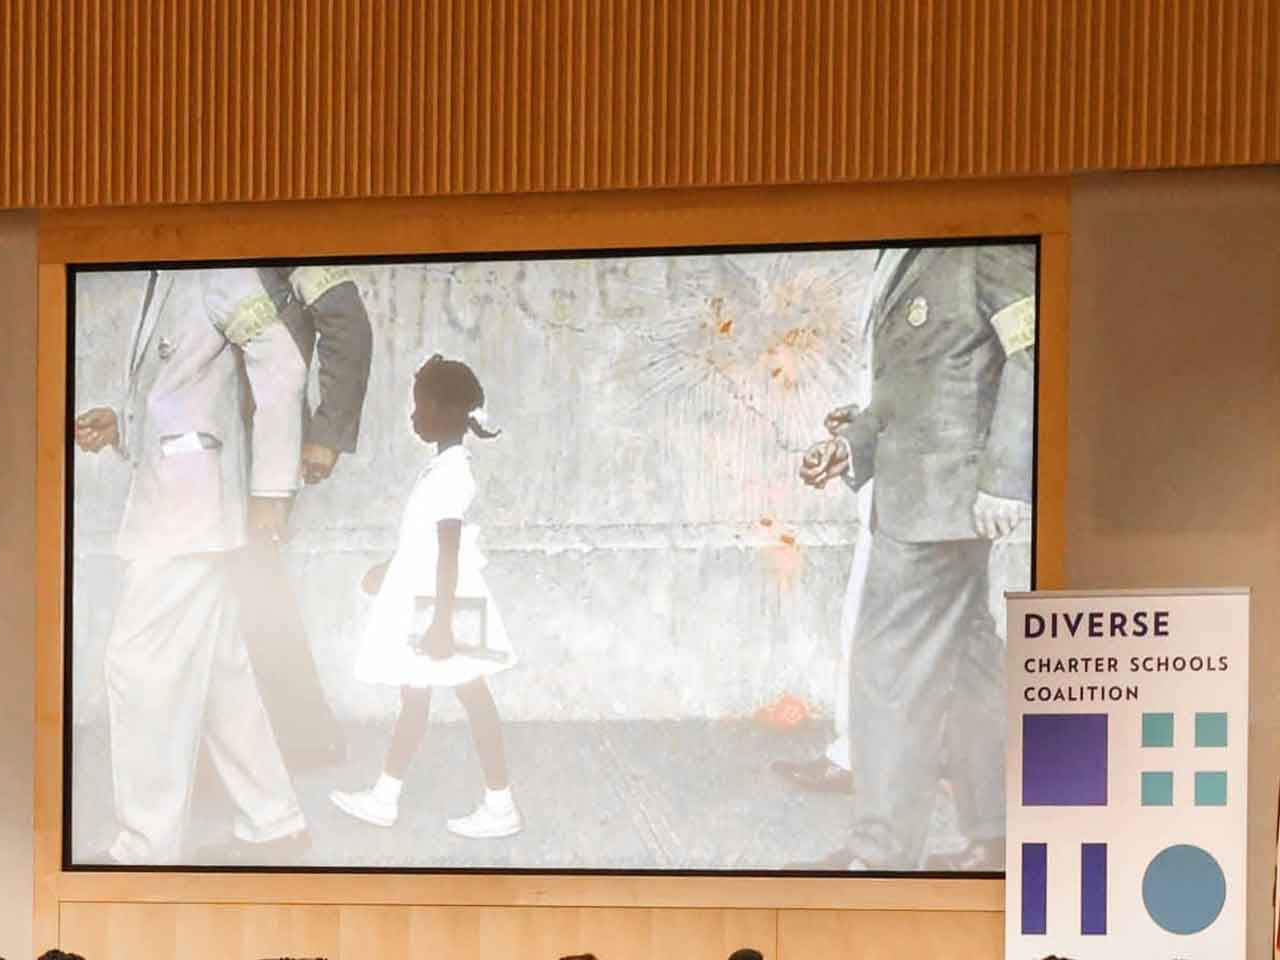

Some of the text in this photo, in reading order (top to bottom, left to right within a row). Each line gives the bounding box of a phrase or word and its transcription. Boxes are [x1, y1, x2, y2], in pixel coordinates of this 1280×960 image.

[1024, 611, 1170, 638] DIVERSE
[1023, 655, 1229, 674] CHARTER SCHOOLS
[1023, 685, 1138, 702] COALITION
